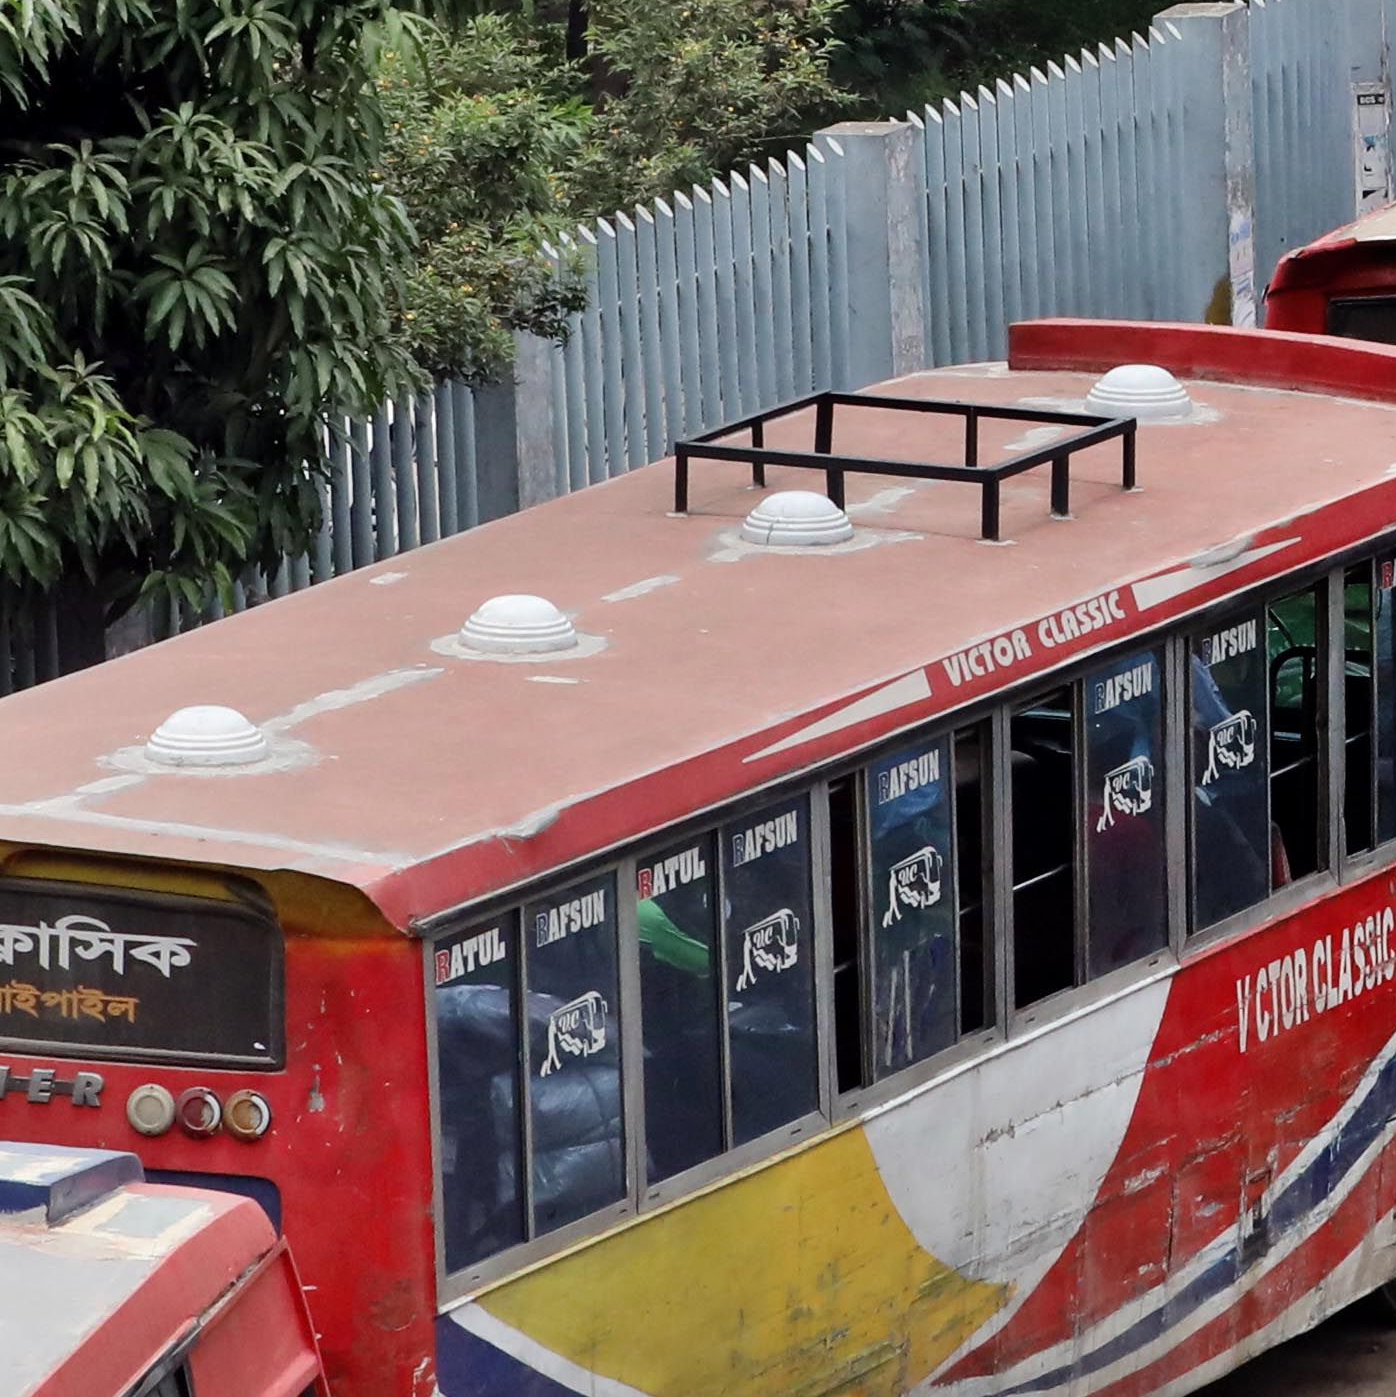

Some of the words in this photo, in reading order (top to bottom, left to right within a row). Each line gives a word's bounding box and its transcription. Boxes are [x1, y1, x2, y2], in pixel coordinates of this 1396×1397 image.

[942, 629, 1033, 687] VICTOR
[1036, 590, 1126, 648] CLASSIC
[878, 748, 940, 805] RAFSUN
[732, 810, 798, 868] RAFSUN
[637, 846, 706, 901] RATUL
[535, 889, 606, 948] RAFSUN
[434, 927, 506, 986] RATUL
[1236, 947, 1310, 1054] VCTOR
[1312, 906, 1396, 1015] CLASSIC
[0, 979, 140, 1025] াইপাইল
